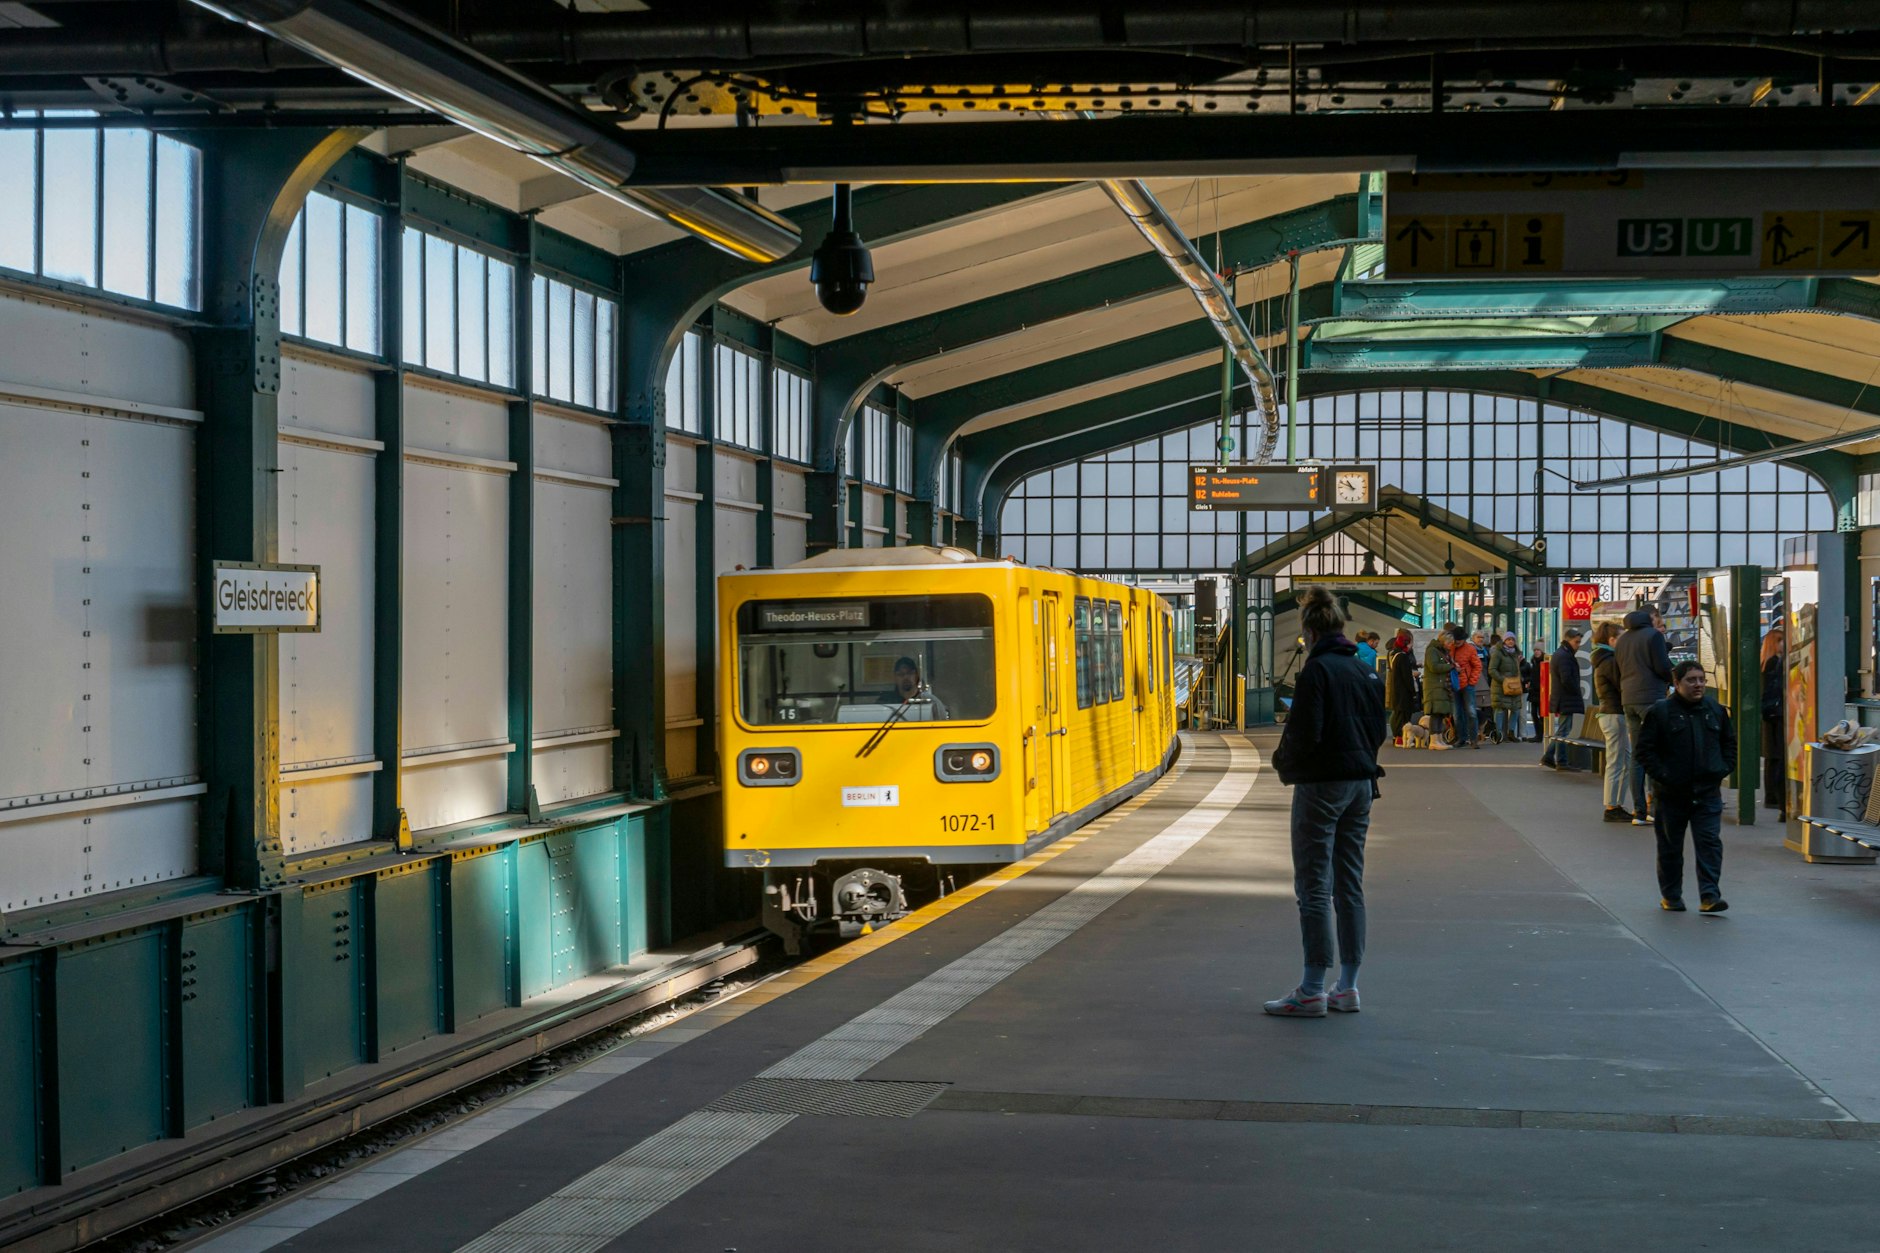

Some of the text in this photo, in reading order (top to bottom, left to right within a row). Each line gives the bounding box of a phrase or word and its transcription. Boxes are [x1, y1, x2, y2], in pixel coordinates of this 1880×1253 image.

[1625, 222, 1742, 253] U3 U1
[1195, 476, 1207, 486] U2
[1195, 489, 1207, 499] U2
[219, 579, 314, 611] Gleisdreieck
[765, 609, 865, 623] Theodor-Heuss-Platz
[1572, 607, 1590, 616] SOS
[779, 708, 796, 720] 15
[846, 792, 876, 801] BERLIN
[940, 813, 996, 832] 1072-1
